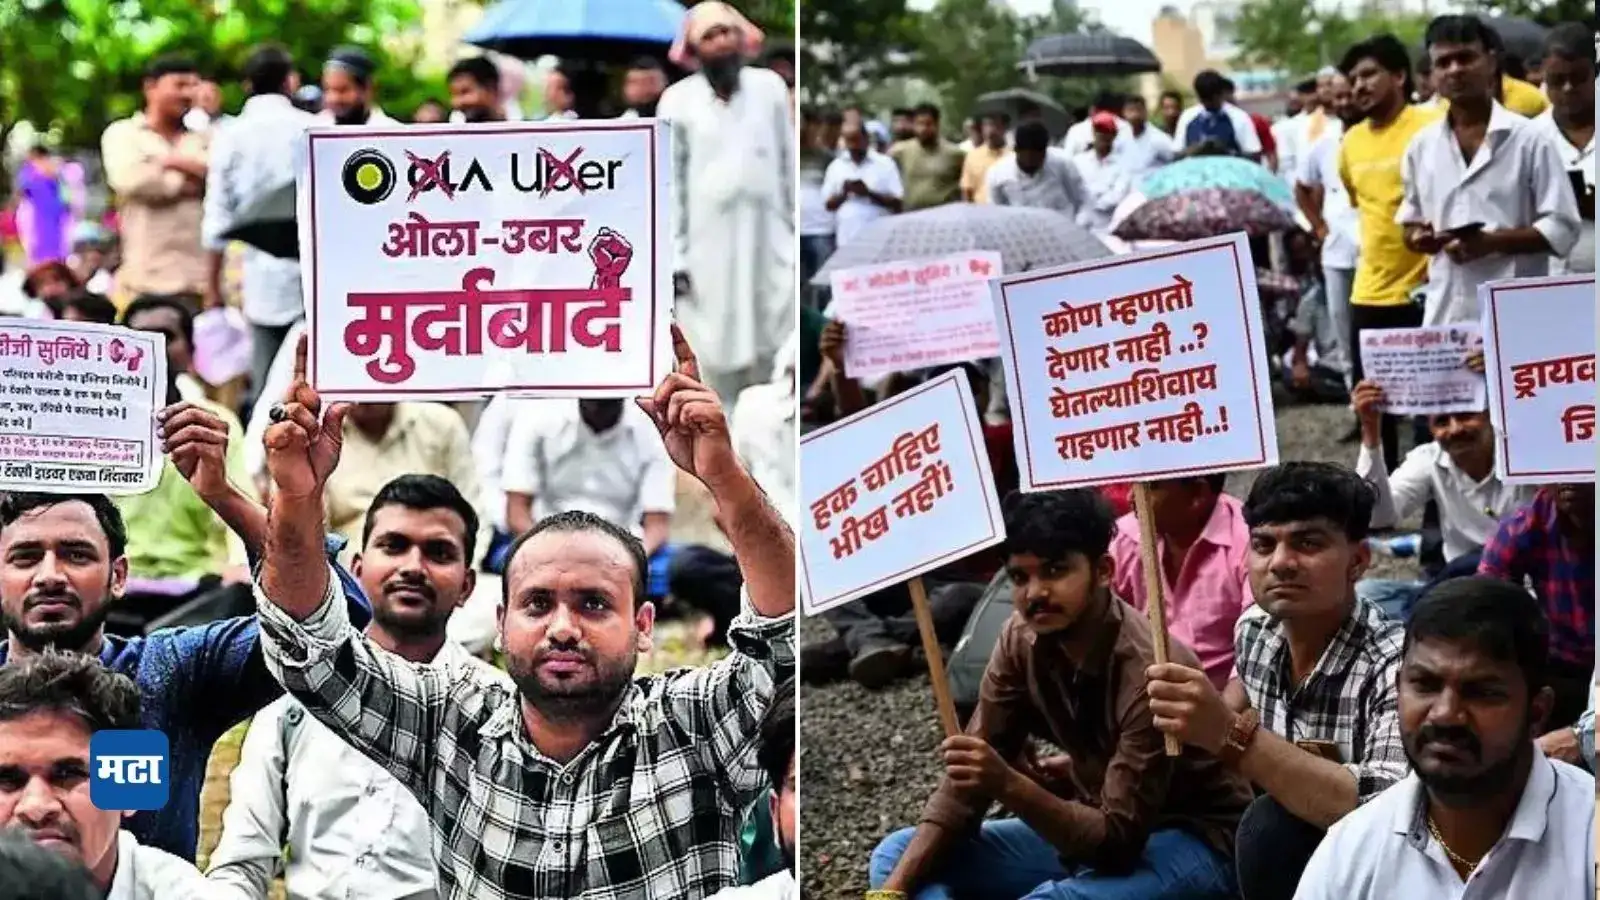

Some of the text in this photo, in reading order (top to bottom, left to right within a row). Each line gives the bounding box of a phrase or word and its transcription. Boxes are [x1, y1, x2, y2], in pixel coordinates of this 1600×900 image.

[406, 156, 493, 193] OLA
[343, 267, 632, 384] मुर्दाबाद
[1042, 301, 1103, 338] कोण
[1107, 273, 1194, 325] म्हणतो
[36, 336, 91, 365] सुनिये
[1045, 342, 1111, 380] देणार
[1113, 321, 1172, 363] नाही
[1049, 364, 1218, 419] घेतल्याशिवाय
[1055, 421, 1141, 461] राहणार
[809, 422, 942, 531] हक चाहिए
[829, 504, 889, 561] भीख
